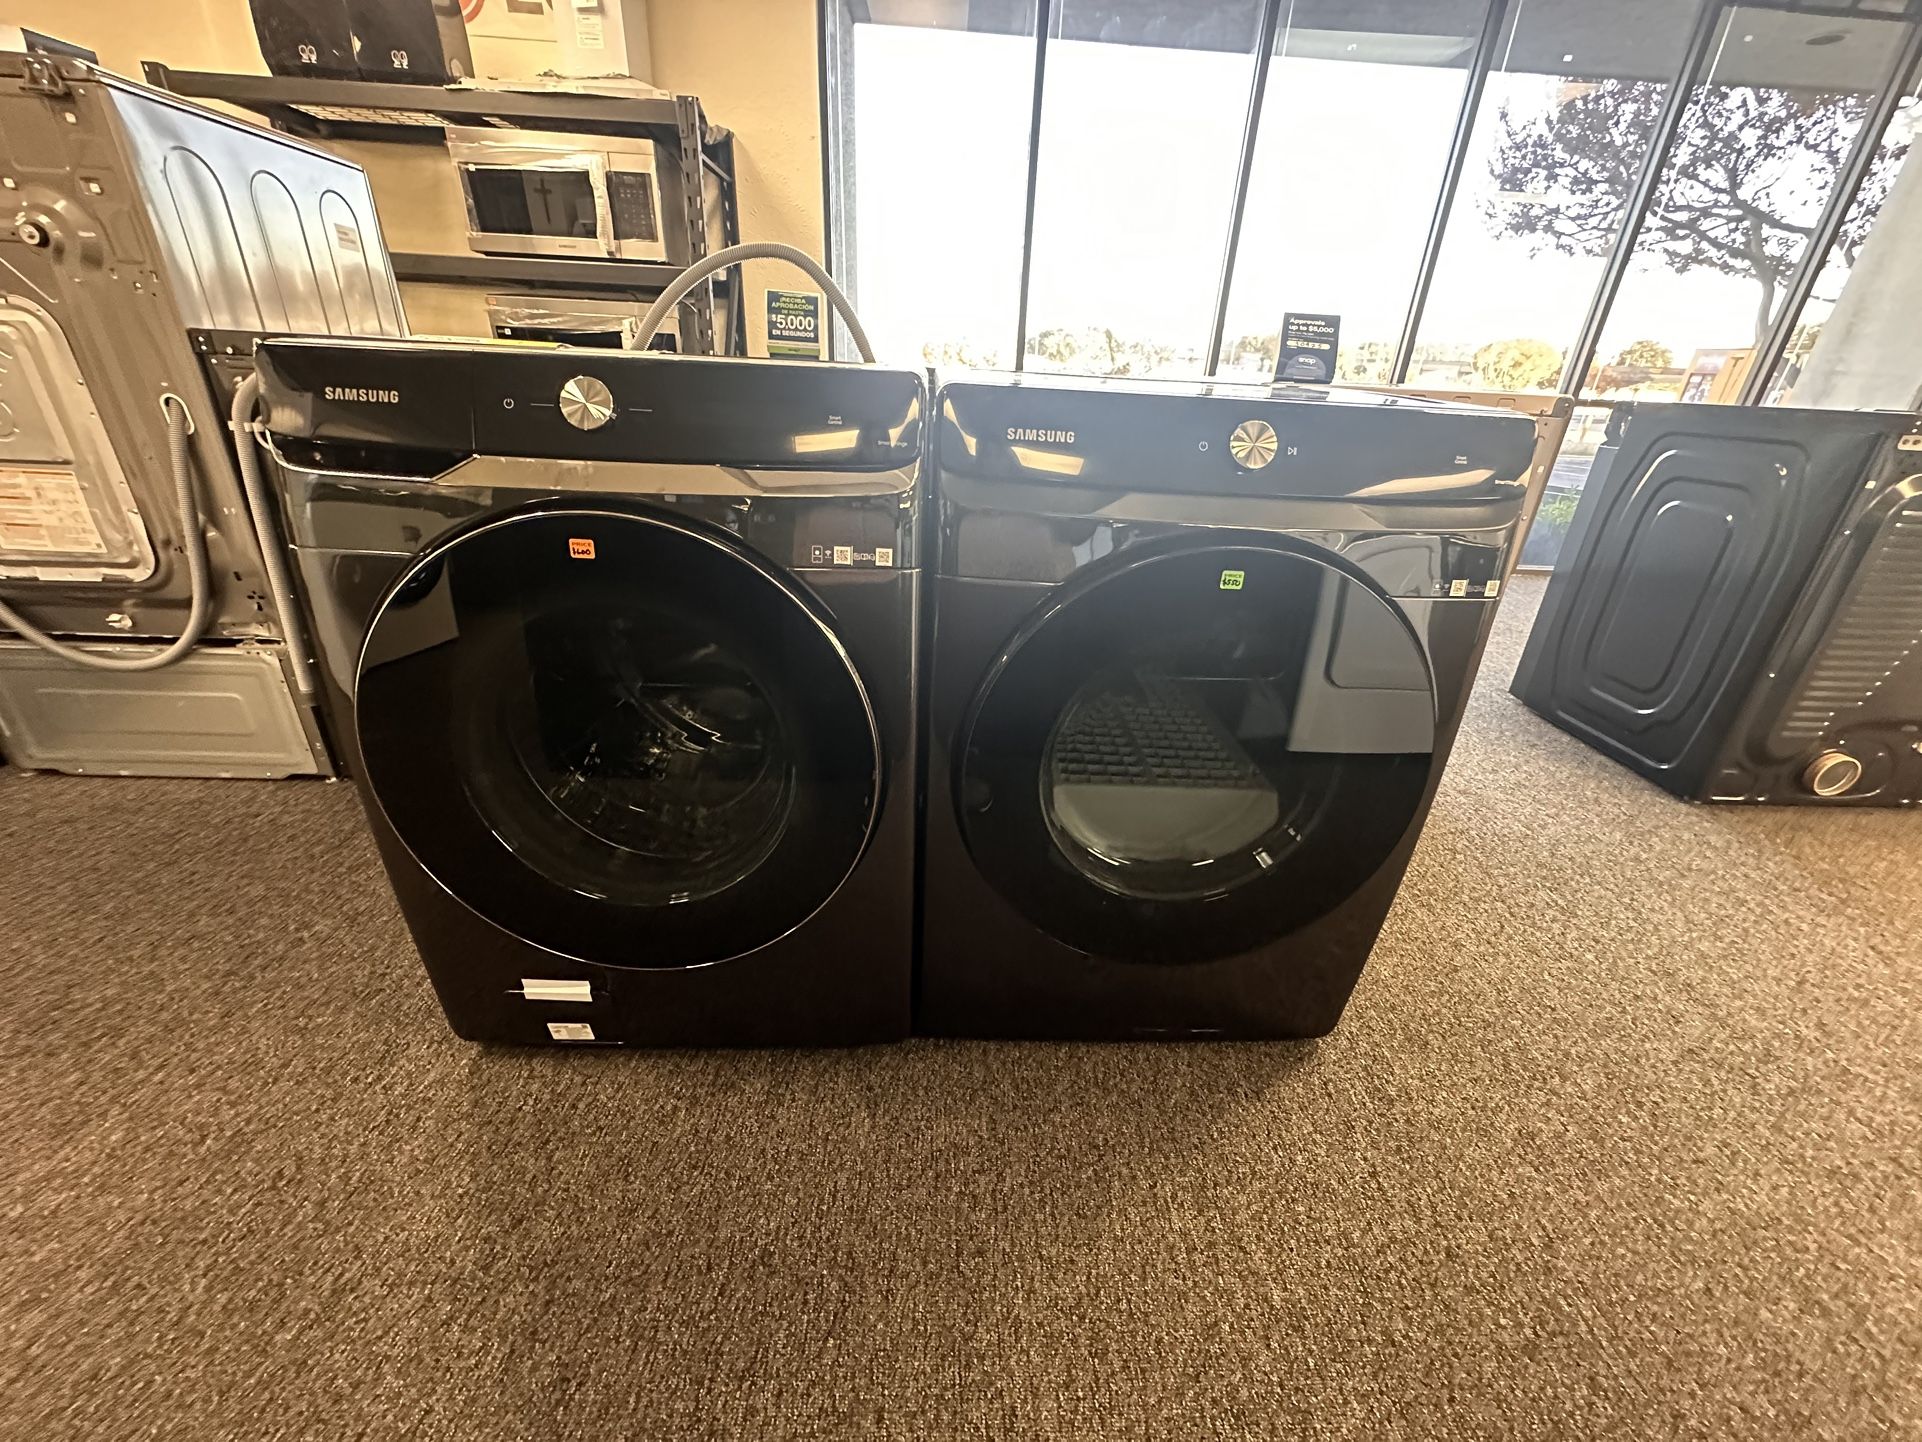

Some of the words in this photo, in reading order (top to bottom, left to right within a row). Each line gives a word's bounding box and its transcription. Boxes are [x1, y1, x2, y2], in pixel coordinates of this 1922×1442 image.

[771, 302, 814, 311] APROBACIÓN
[771, 314, 815, 331] $5,000
[1289, 317, 1325, 326] Approvals
[782, 330, 815, 338] SEGUNDOS
[325, 386, 399, 404] SAMSUNG
[1007, 427, 1075, 444] SAMSUNG
